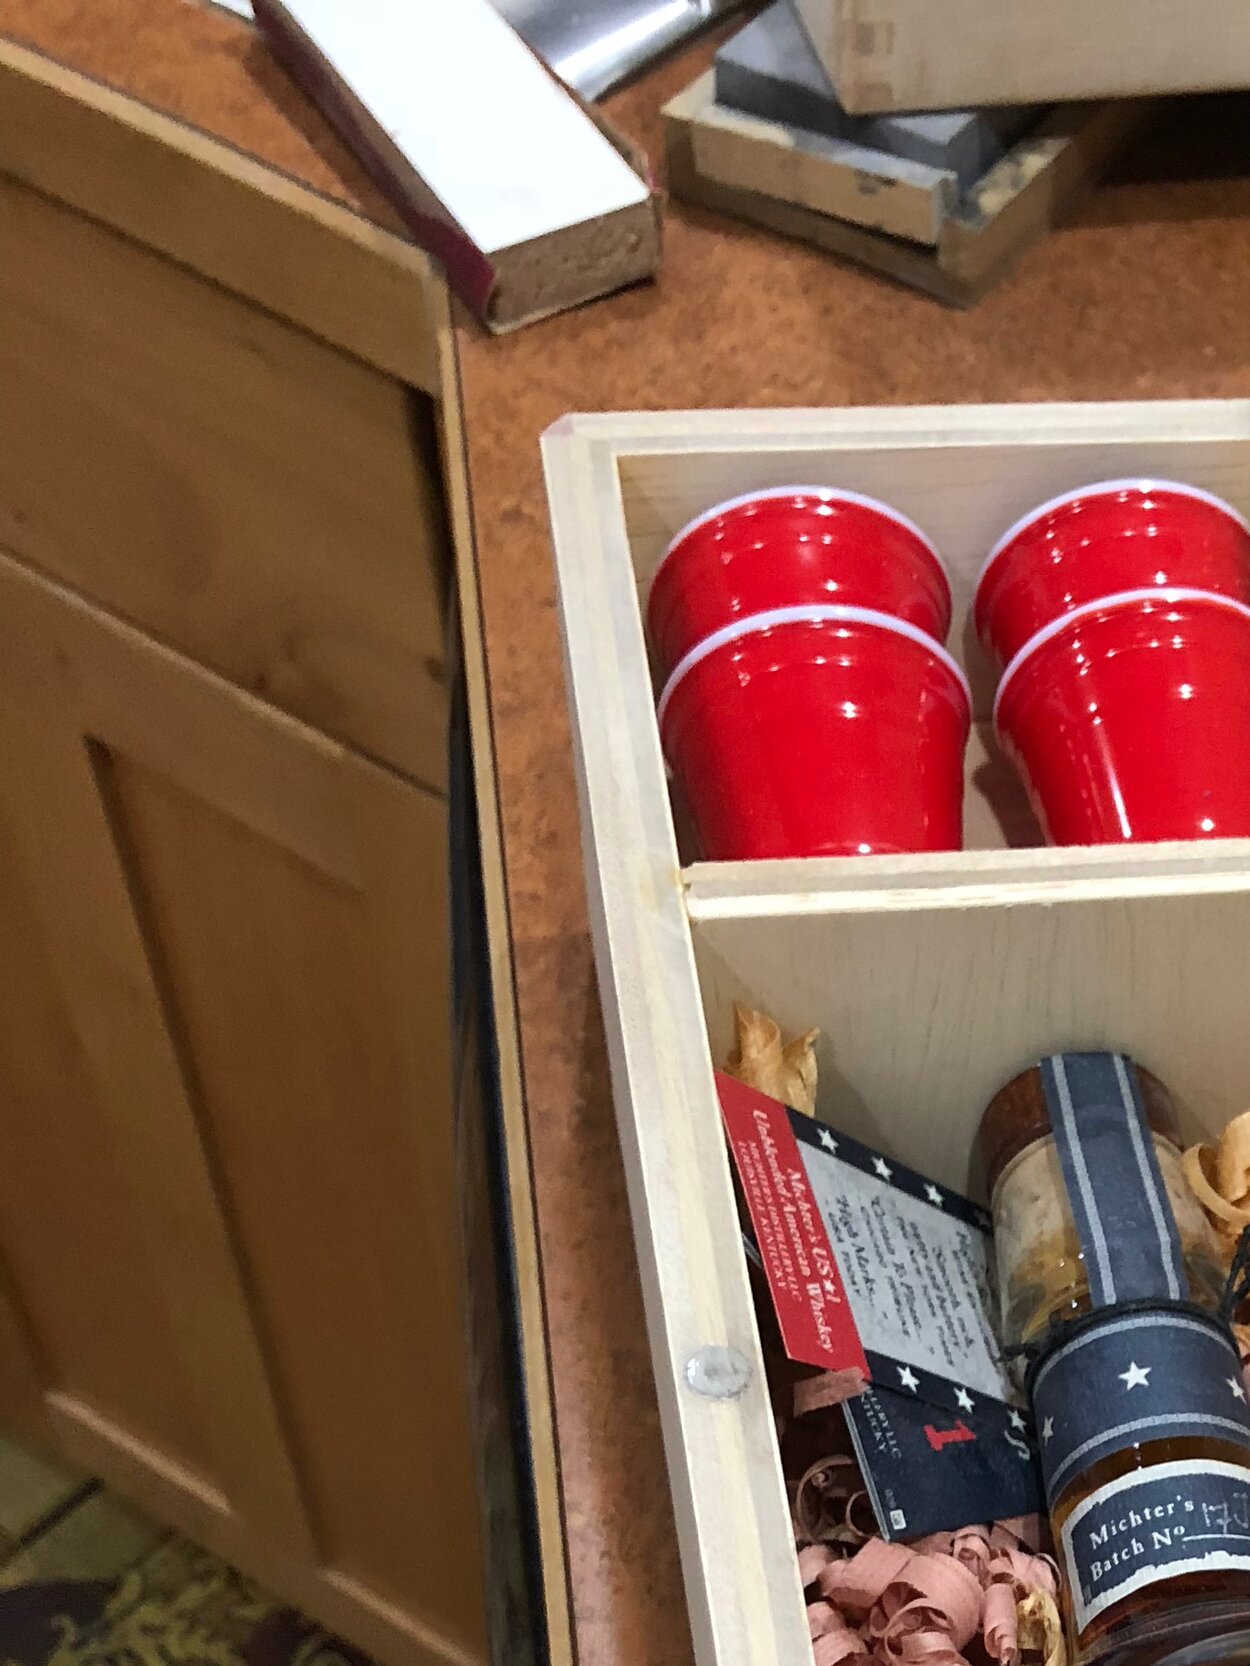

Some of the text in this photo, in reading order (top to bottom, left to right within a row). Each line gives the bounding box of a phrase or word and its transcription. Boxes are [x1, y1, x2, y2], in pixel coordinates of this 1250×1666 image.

[753, 1108, 835, 1354] Unblended American Whiskey
[1088, 1494, 1195, 1551] Michter's
[1089, 1536, 1145, 1583] Batch
